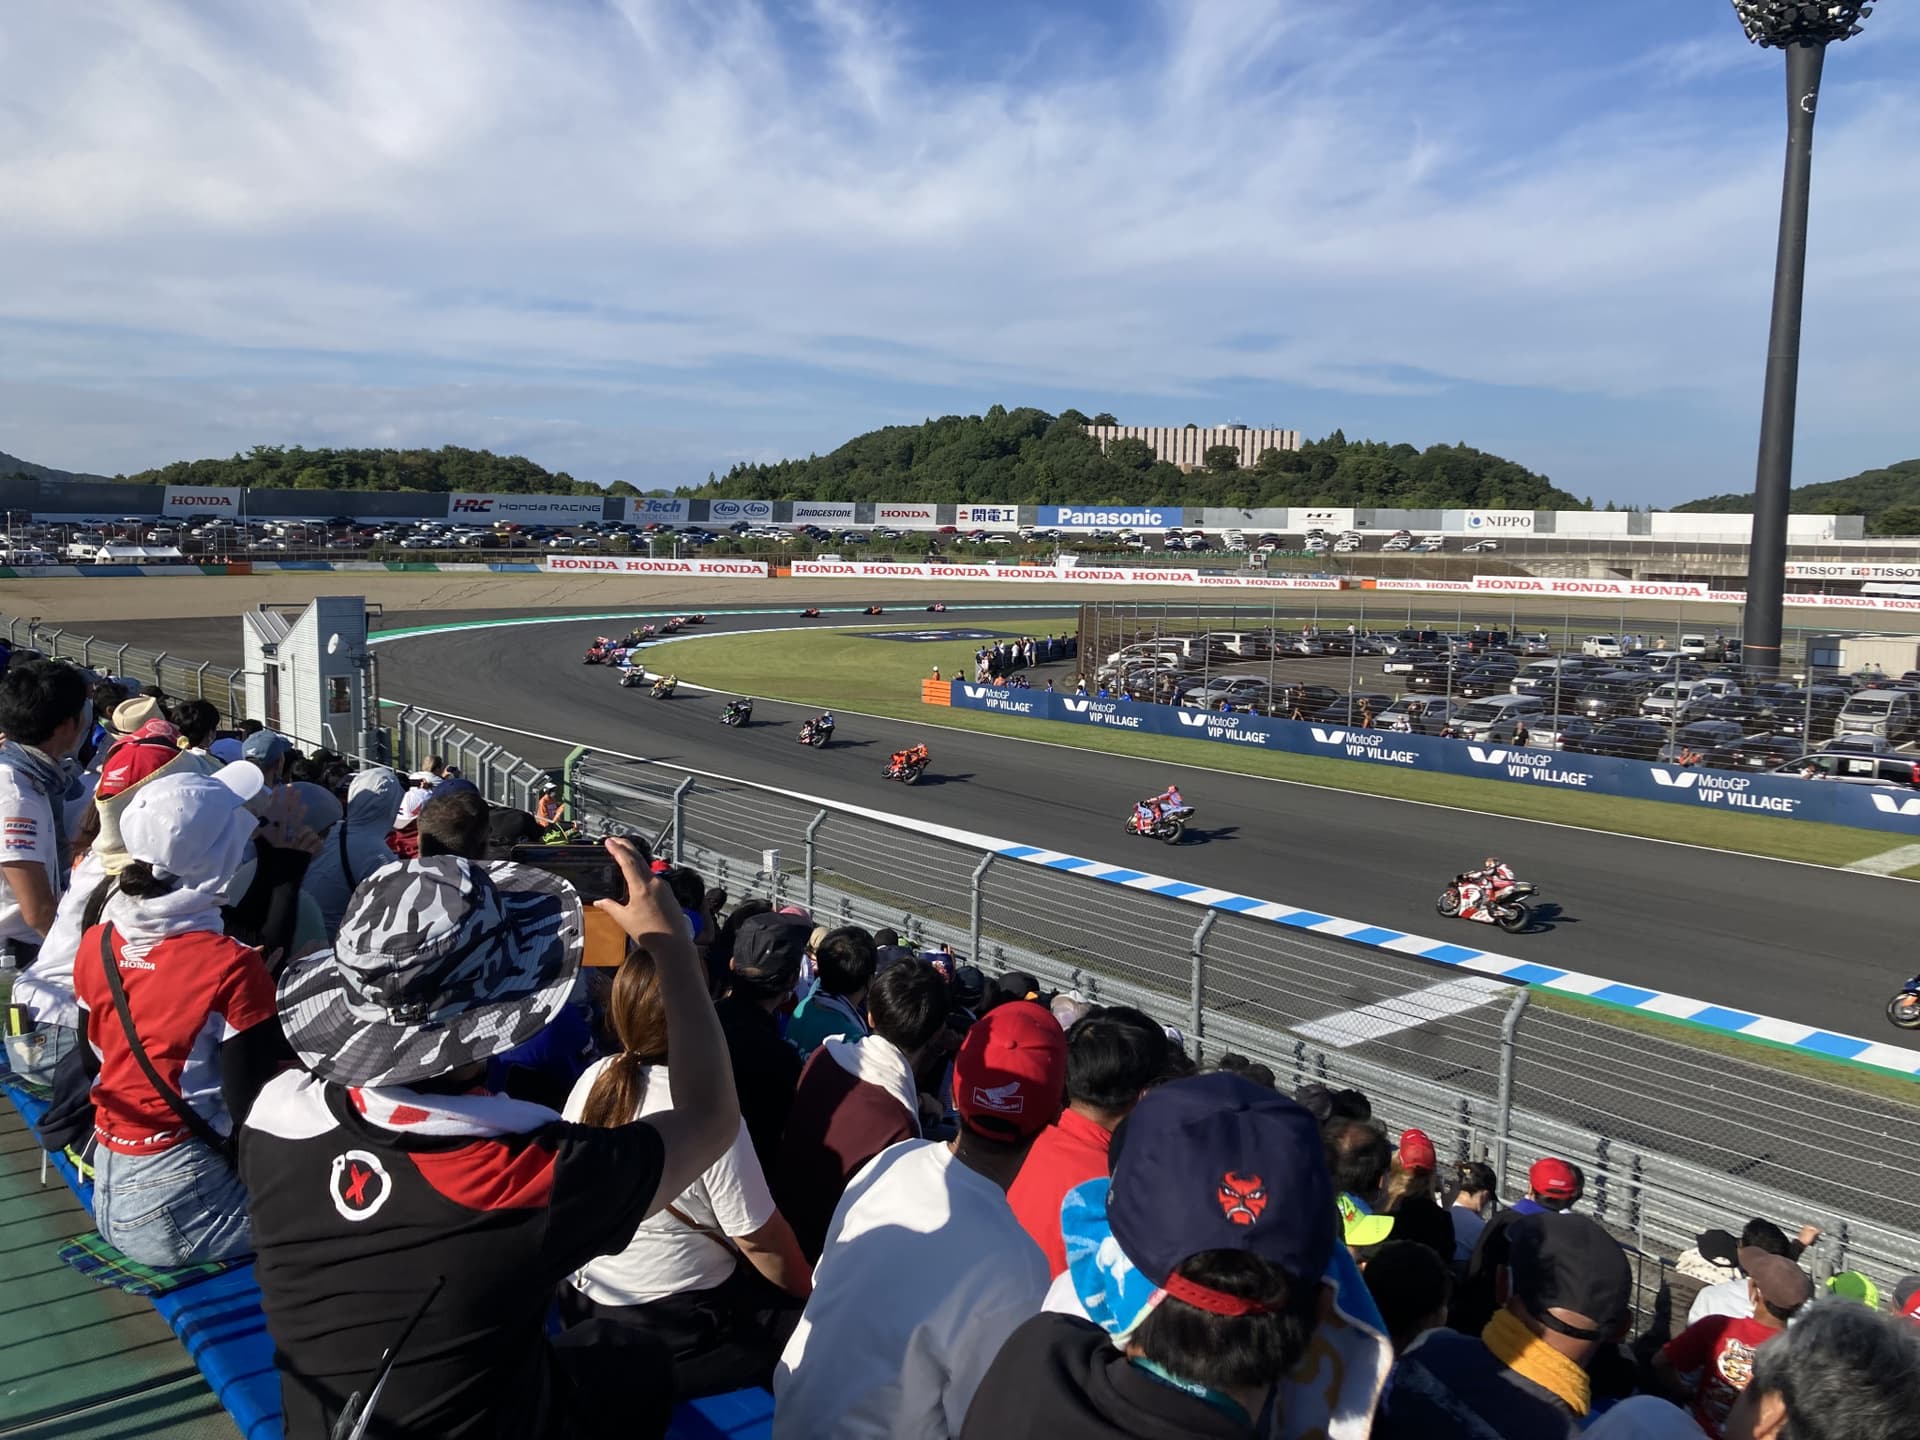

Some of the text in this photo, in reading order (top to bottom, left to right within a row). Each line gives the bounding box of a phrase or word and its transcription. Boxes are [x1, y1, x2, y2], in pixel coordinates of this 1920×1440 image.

[171, 495, 232, 506] HONDA
[499, 503, 547, 511] Honda
[550, 503, 601, 512] RACING
[796, 508, 853, 518] BRIDGESTONE
[880, 510, 931, 519] HONDA
[971, 508, 1016, 523] 関電工
[1058, 508, 1163, 526] Panasonic
[1486, 516, 1531, 528] NIPPO
[551, 559, 764, 574] HONDA HONDA HONDA
[1797, 566, 1846, 575] TISSOT
[795, 564, 1194, 582] HONDA HONDA HONDA HONDA HONDA HONDA
[1200, 577, 1241, 585] HONDA
[1293, 580, 1337, 588] HONDA
[1379, 581, 1470, 590] HONDA HONDA
[1477, 579, 1703, 597] HONDA HONDA HONDA
[1823, 597, 1876, 607] HONDA
[986, 688, 1010, 698] MotoGP
[986, 699, 998, 708] VIP
[1089, 702, 1116, 714] MotoGP
[1089, 711, 1102, 723] VIP
[1207, 716, 1239, 728] MotoGP
[1207, 726, 1224, 738] VIP
[1345, 732, 1383, 746] MotoGP
[1346, 745, 1365, 757] VIP
[1507, 751, 1552, 767] MotoGP
[1507, 764, 1530, 779] VIP
[1698, 773, 1750, 791] MotoGP
[1698, 788, 1724, 804] VIP
[119, 960, 156, 972] HONDA
